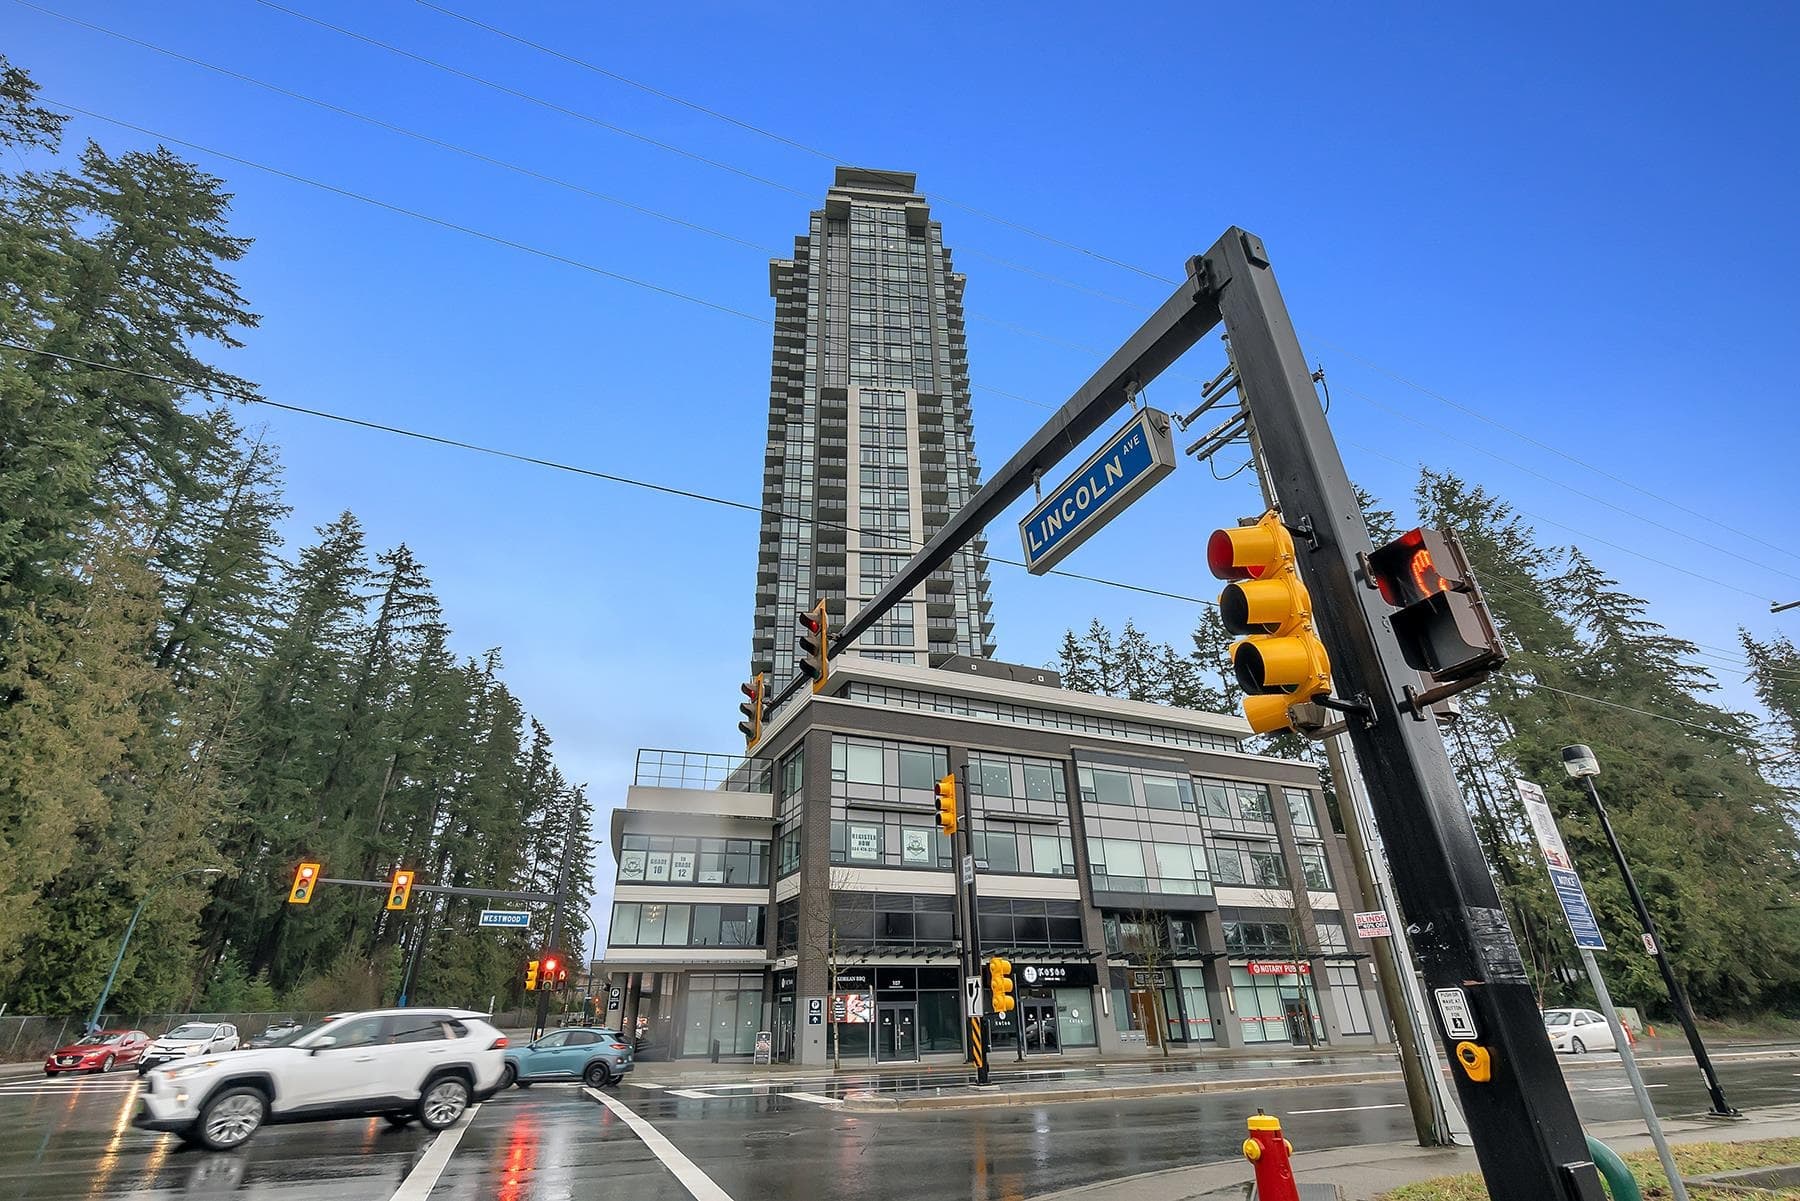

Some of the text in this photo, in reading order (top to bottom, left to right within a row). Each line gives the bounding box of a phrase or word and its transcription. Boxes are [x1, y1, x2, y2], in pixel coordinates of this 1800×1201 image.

[1028, 434, 1140, 552] LINCOLN AVE
[653, 865, 663, 874] 10
[678, 868, 687, 878] 12
[483, 913, 521, 923] WESTWOOD
[1356, 914, 1386, 924] BLINDS
[1260, 964, 1306, 973] NOTARY PUBIC
